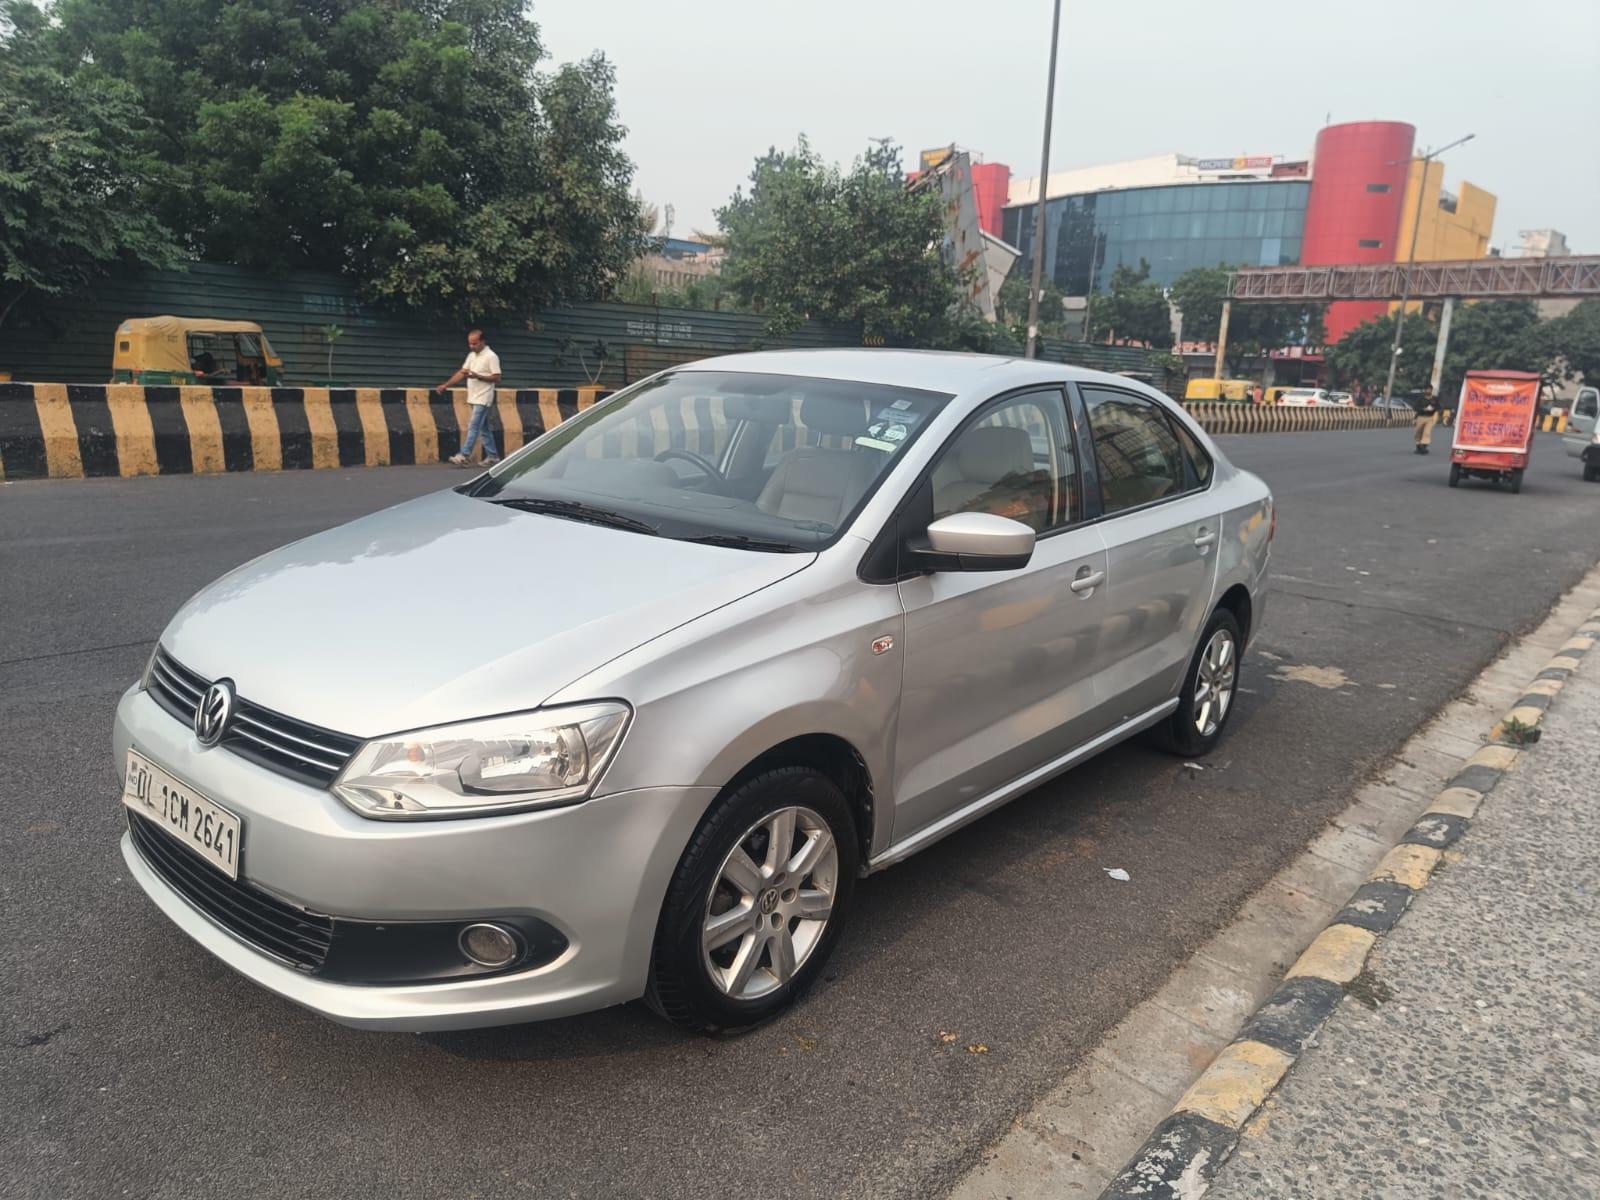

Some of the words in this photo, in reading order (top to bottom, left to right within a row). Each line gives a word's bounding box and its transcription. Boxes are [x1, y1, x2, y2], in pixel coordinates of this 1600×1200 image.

[1461, 421, 1485, 436] FREE
[1487, 422, 1525, 438] SERVICE
[137, 767, 156, 809] DL
[162, 785, 189, 832] 1CM
[194, 806, 234, 864] 2641
